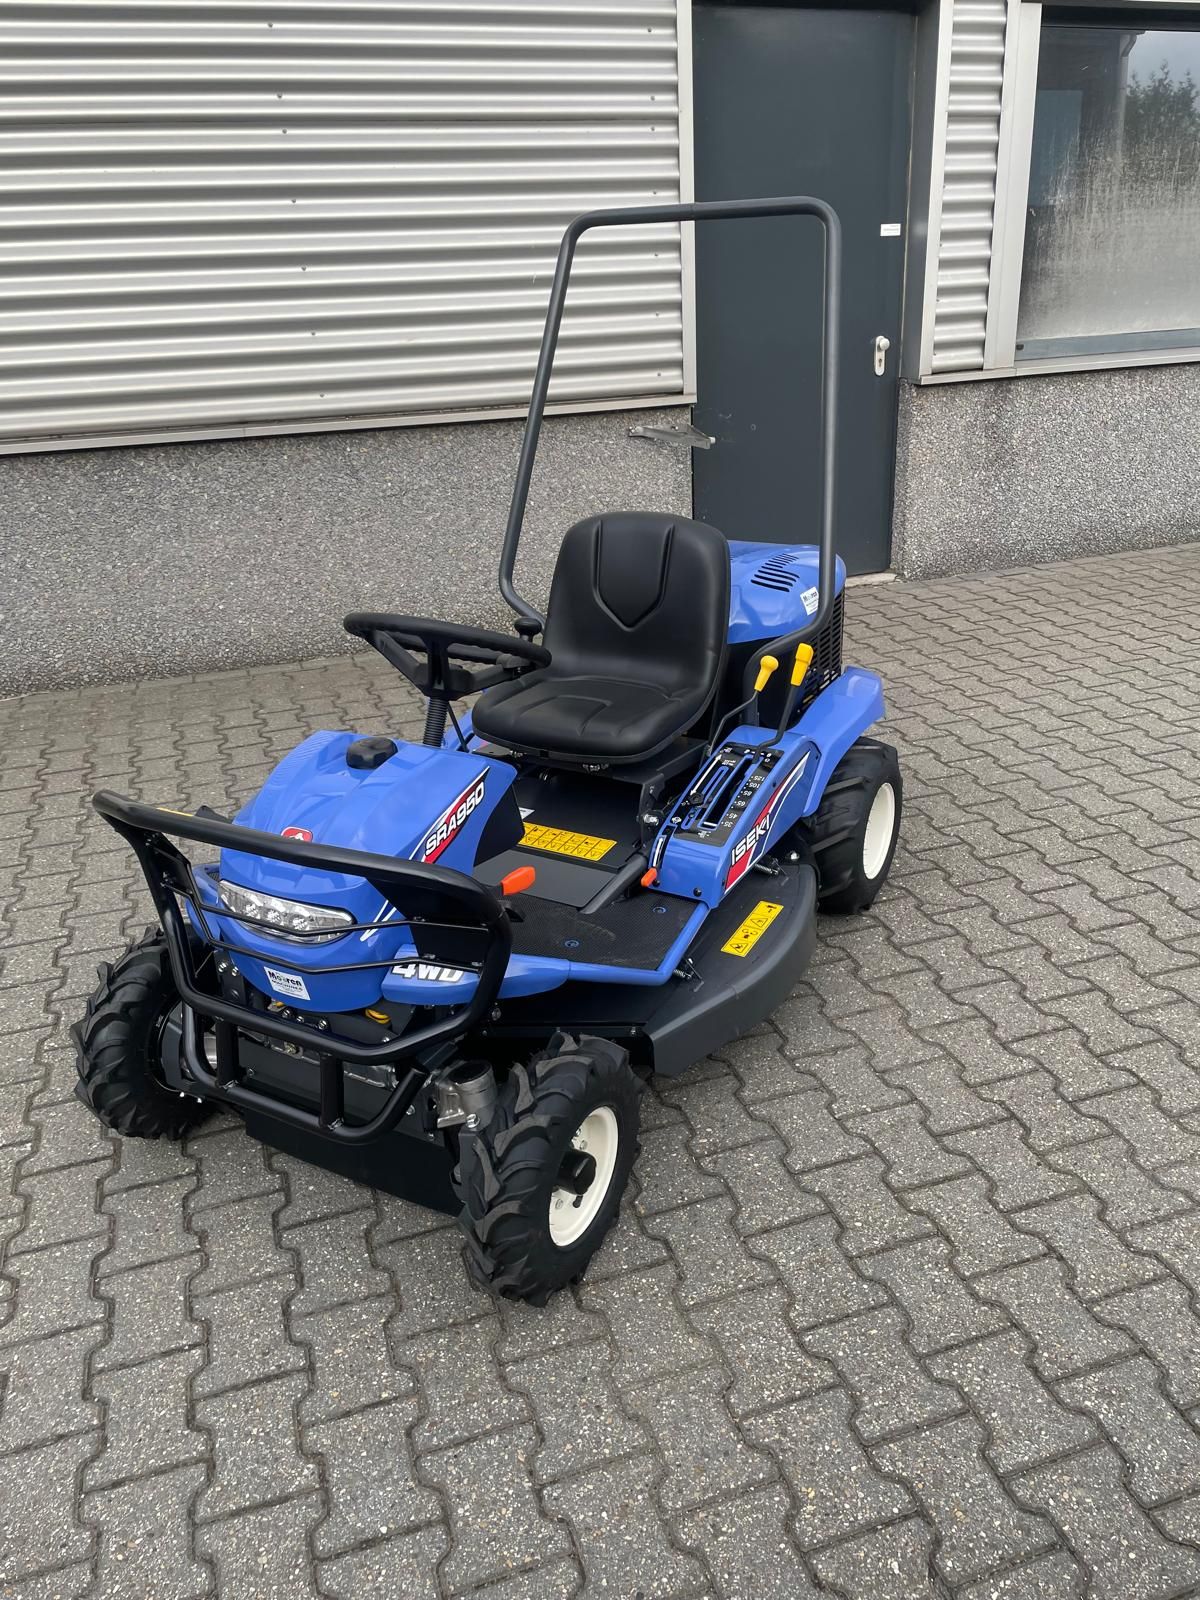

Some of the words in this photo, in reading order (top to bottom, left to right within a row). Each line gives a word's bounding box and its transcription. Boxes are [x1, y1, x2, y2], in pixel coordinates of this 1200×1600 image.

[425, 781, 485, 856] SRA950
[731, 814, 770, 866] ISEKI
[391, 962, 465, 983] 4WD
